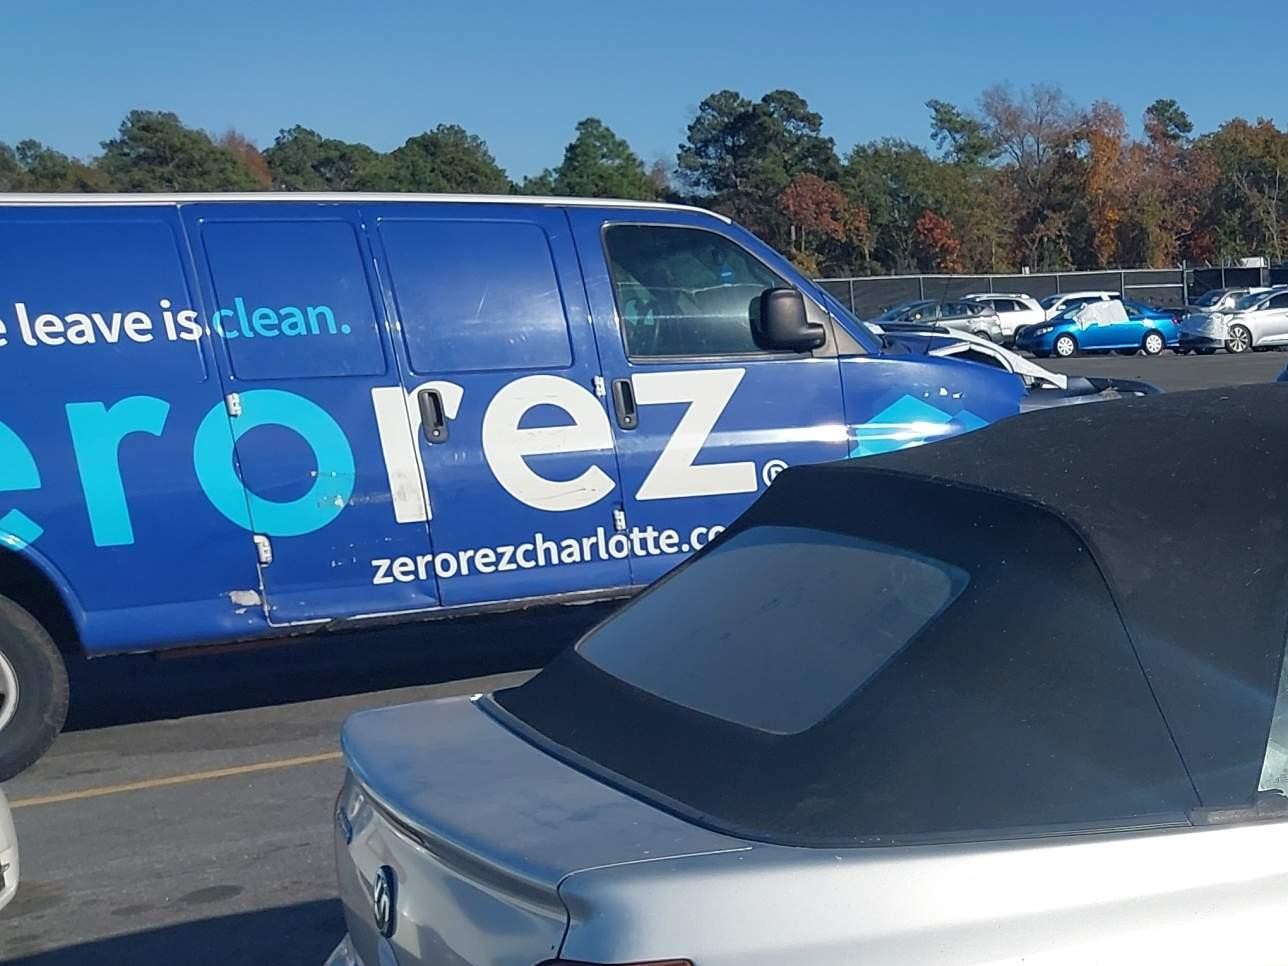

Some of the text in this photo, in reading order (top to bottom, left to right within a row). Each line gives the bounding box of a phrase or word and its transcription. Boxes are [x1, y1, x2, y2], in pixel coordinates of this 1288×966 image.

[14, 302, 154, 347] leave
[159, 299, 203, 342] is
[212, 297, 351, 339] clean.
